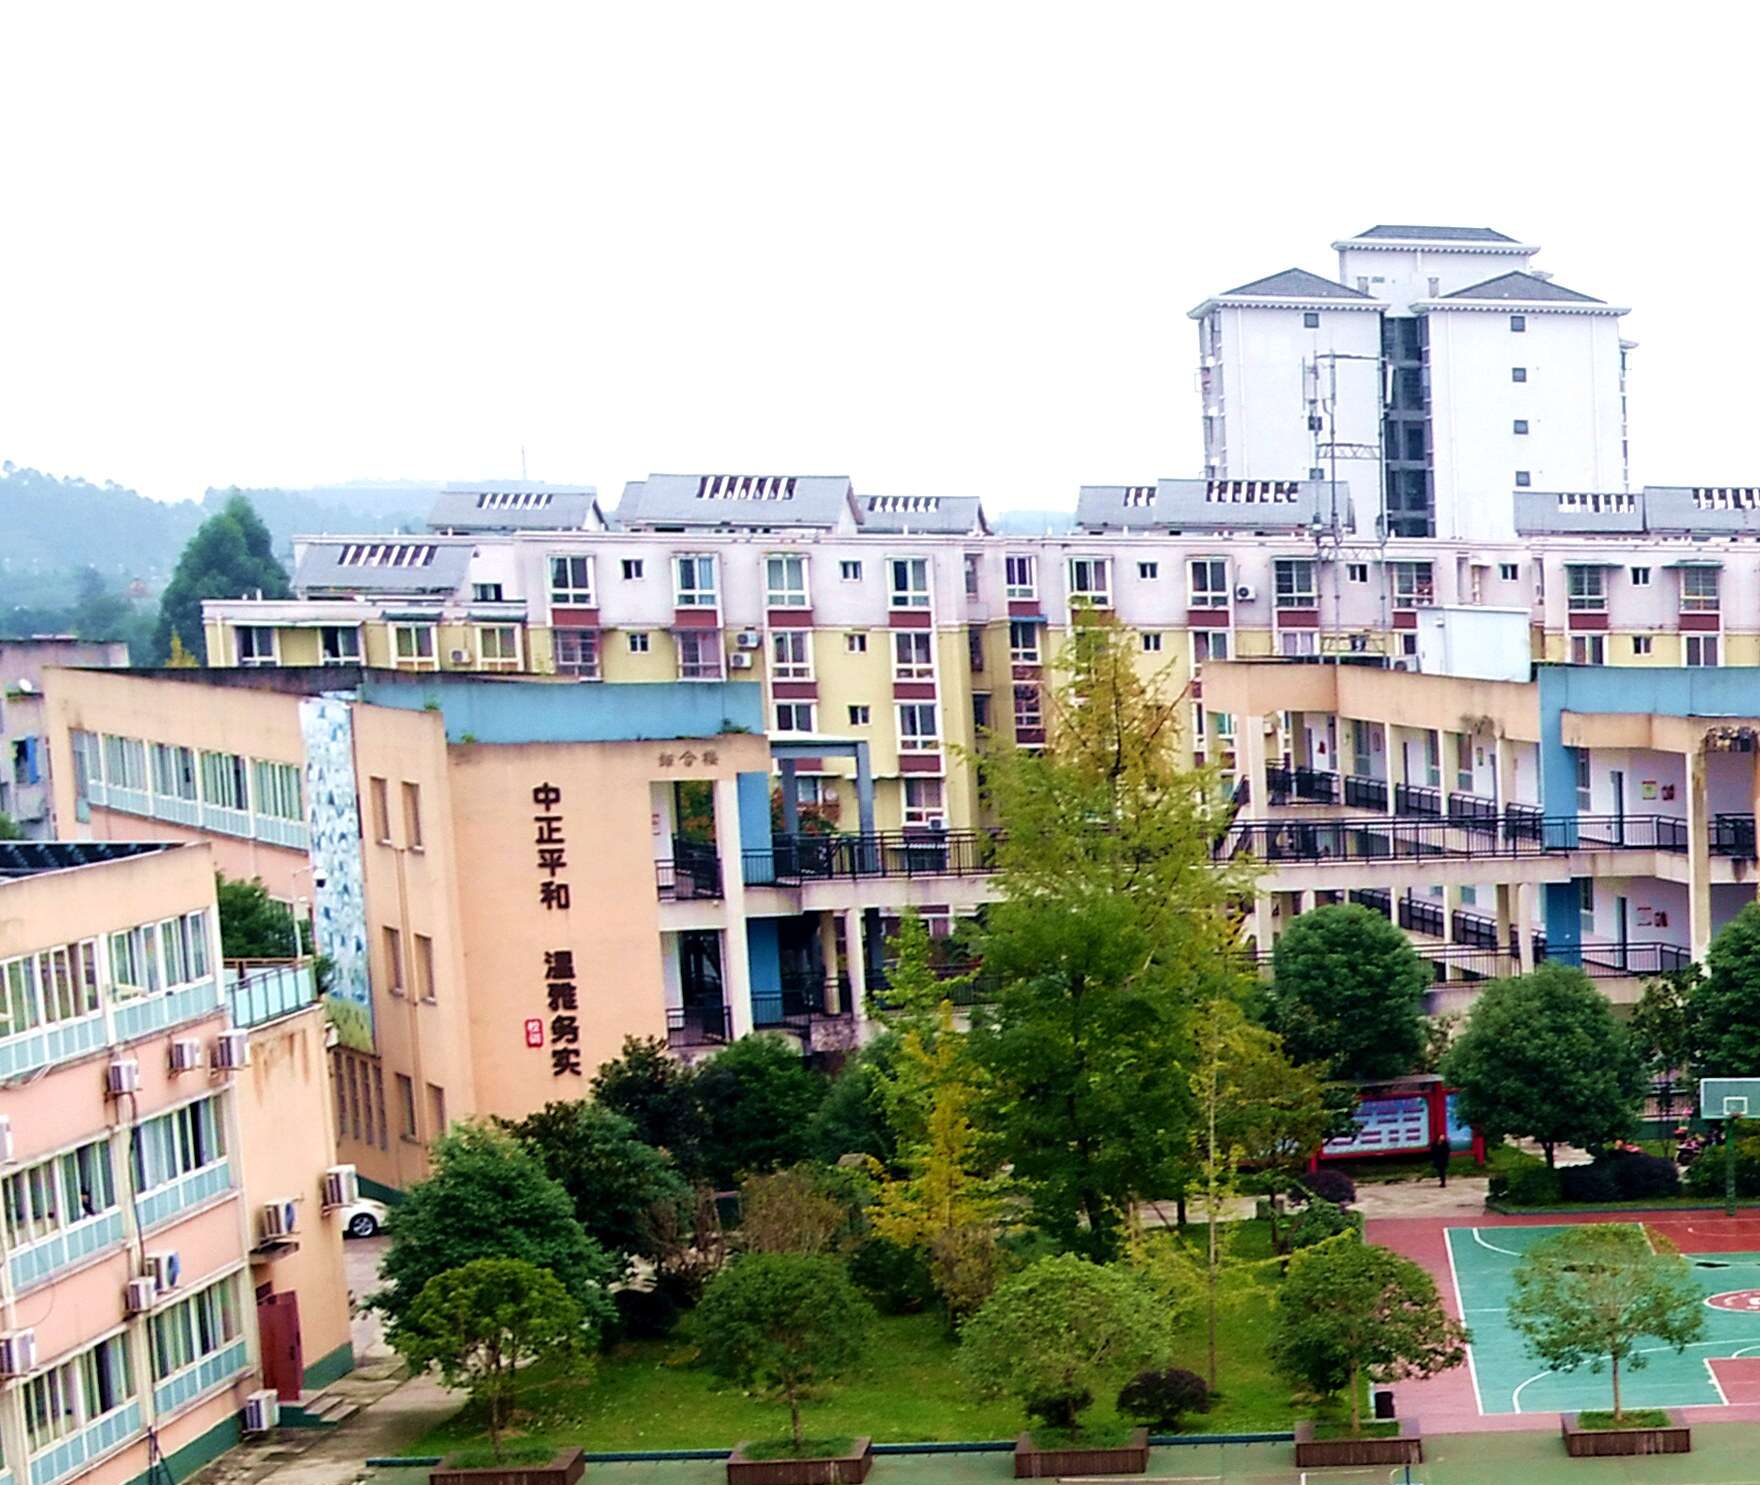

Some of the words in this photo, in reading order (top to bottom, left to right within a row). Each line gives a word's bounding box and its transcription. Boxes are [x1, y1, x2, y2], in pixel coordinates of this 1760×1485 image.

[533, 782, 570, 910] 中正平和
[544, 950, 582, 1076] 温雅务实
